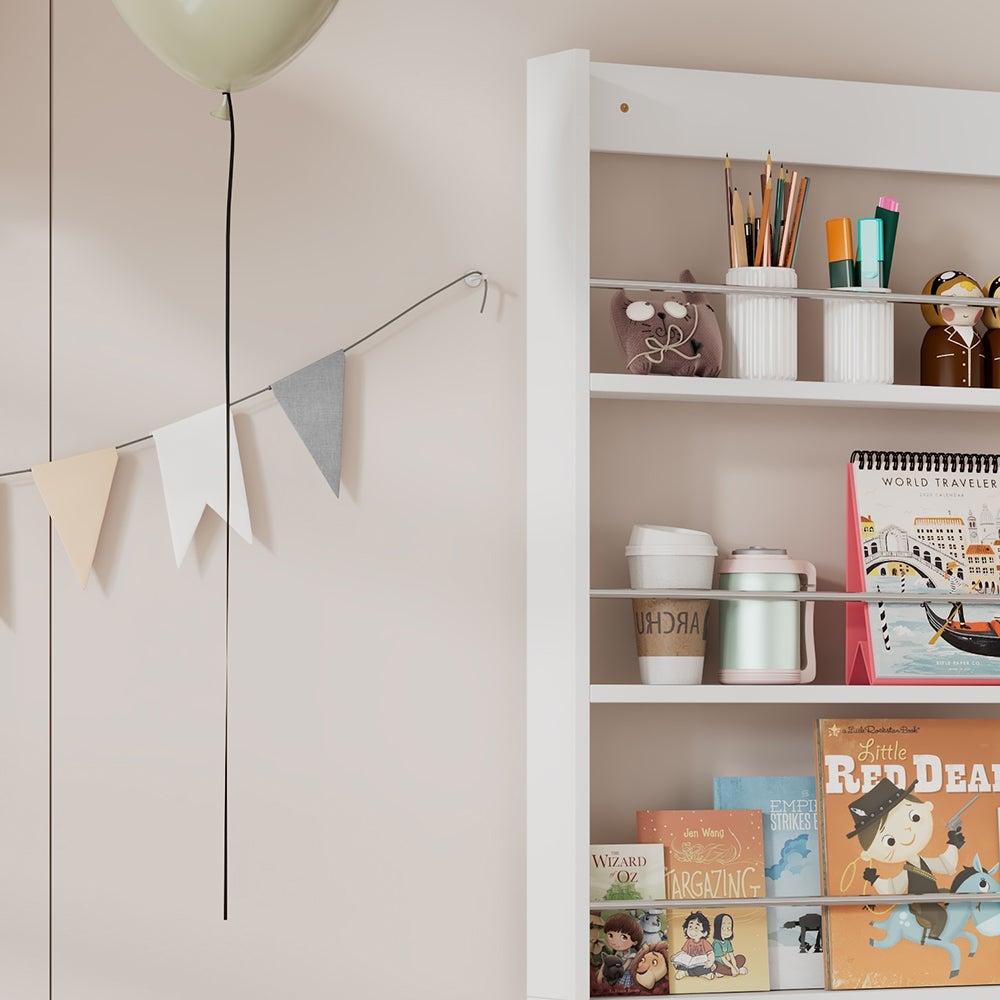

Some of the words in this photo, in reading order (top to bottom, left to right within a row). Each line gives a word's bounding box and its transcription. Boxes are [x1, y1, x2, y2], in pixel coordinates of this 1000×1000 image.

[882, 477, 929, 487] WORLD
[935, 478, 998, 488] TRAVELER
[857, 738, 908, 763] Little
[824, 754, 907, 794] RED
[769, 799, 818, 813] EMPI
[770, 812, 811, 831] STRIKES
[683, 828, 699, 838] Jen
[701, 828, 725, 839] Wang
[592, 854, 647, 868] WIZARD
[665, 866, 761, 899] TARGAZING
